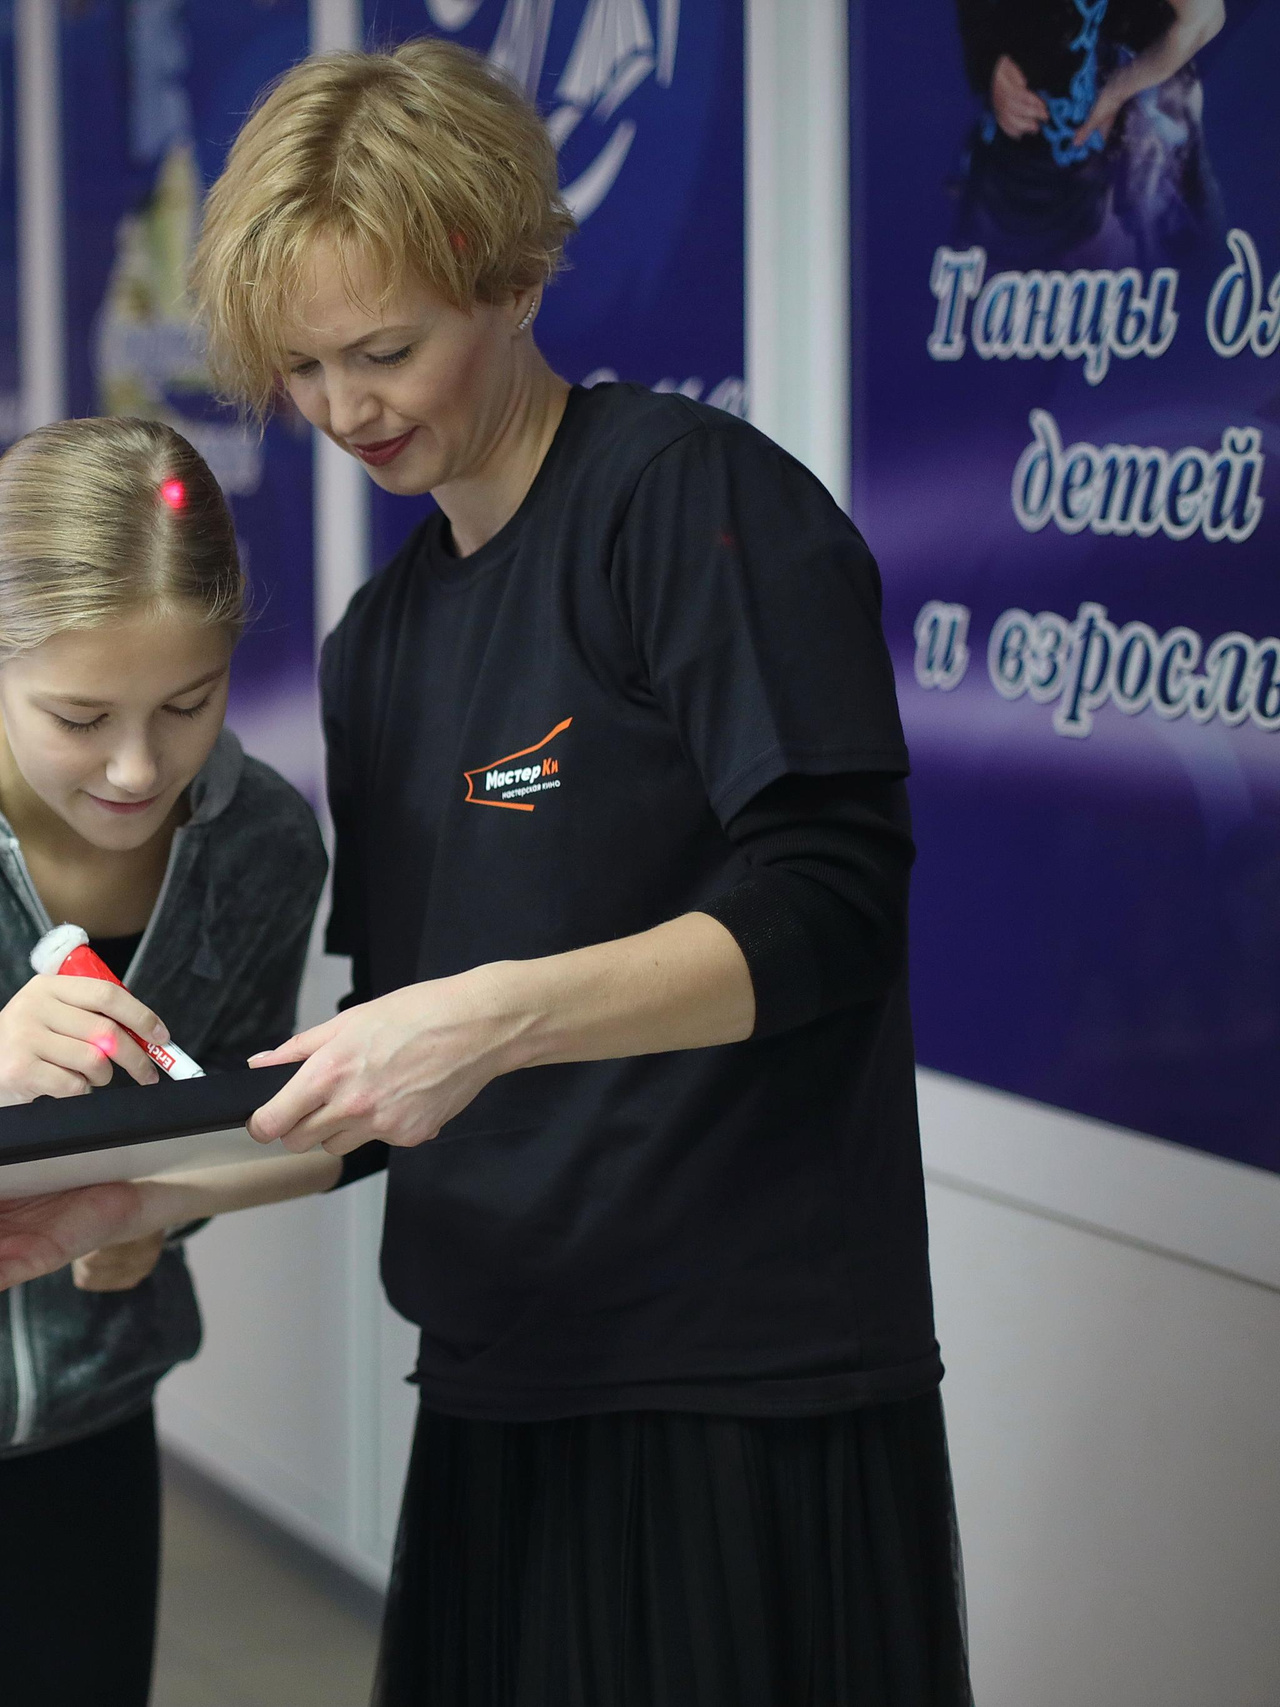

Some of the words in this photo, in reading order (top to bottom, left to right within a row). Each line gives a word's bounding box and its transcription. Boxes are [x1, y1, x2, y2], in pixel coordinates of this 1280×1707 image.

[927, 245, 1179, 386] Танцы
[1011, 407, 1265, 543] детей
[914, 600, 971, 691] и
[146, 1042, 174, 1068] Erich
